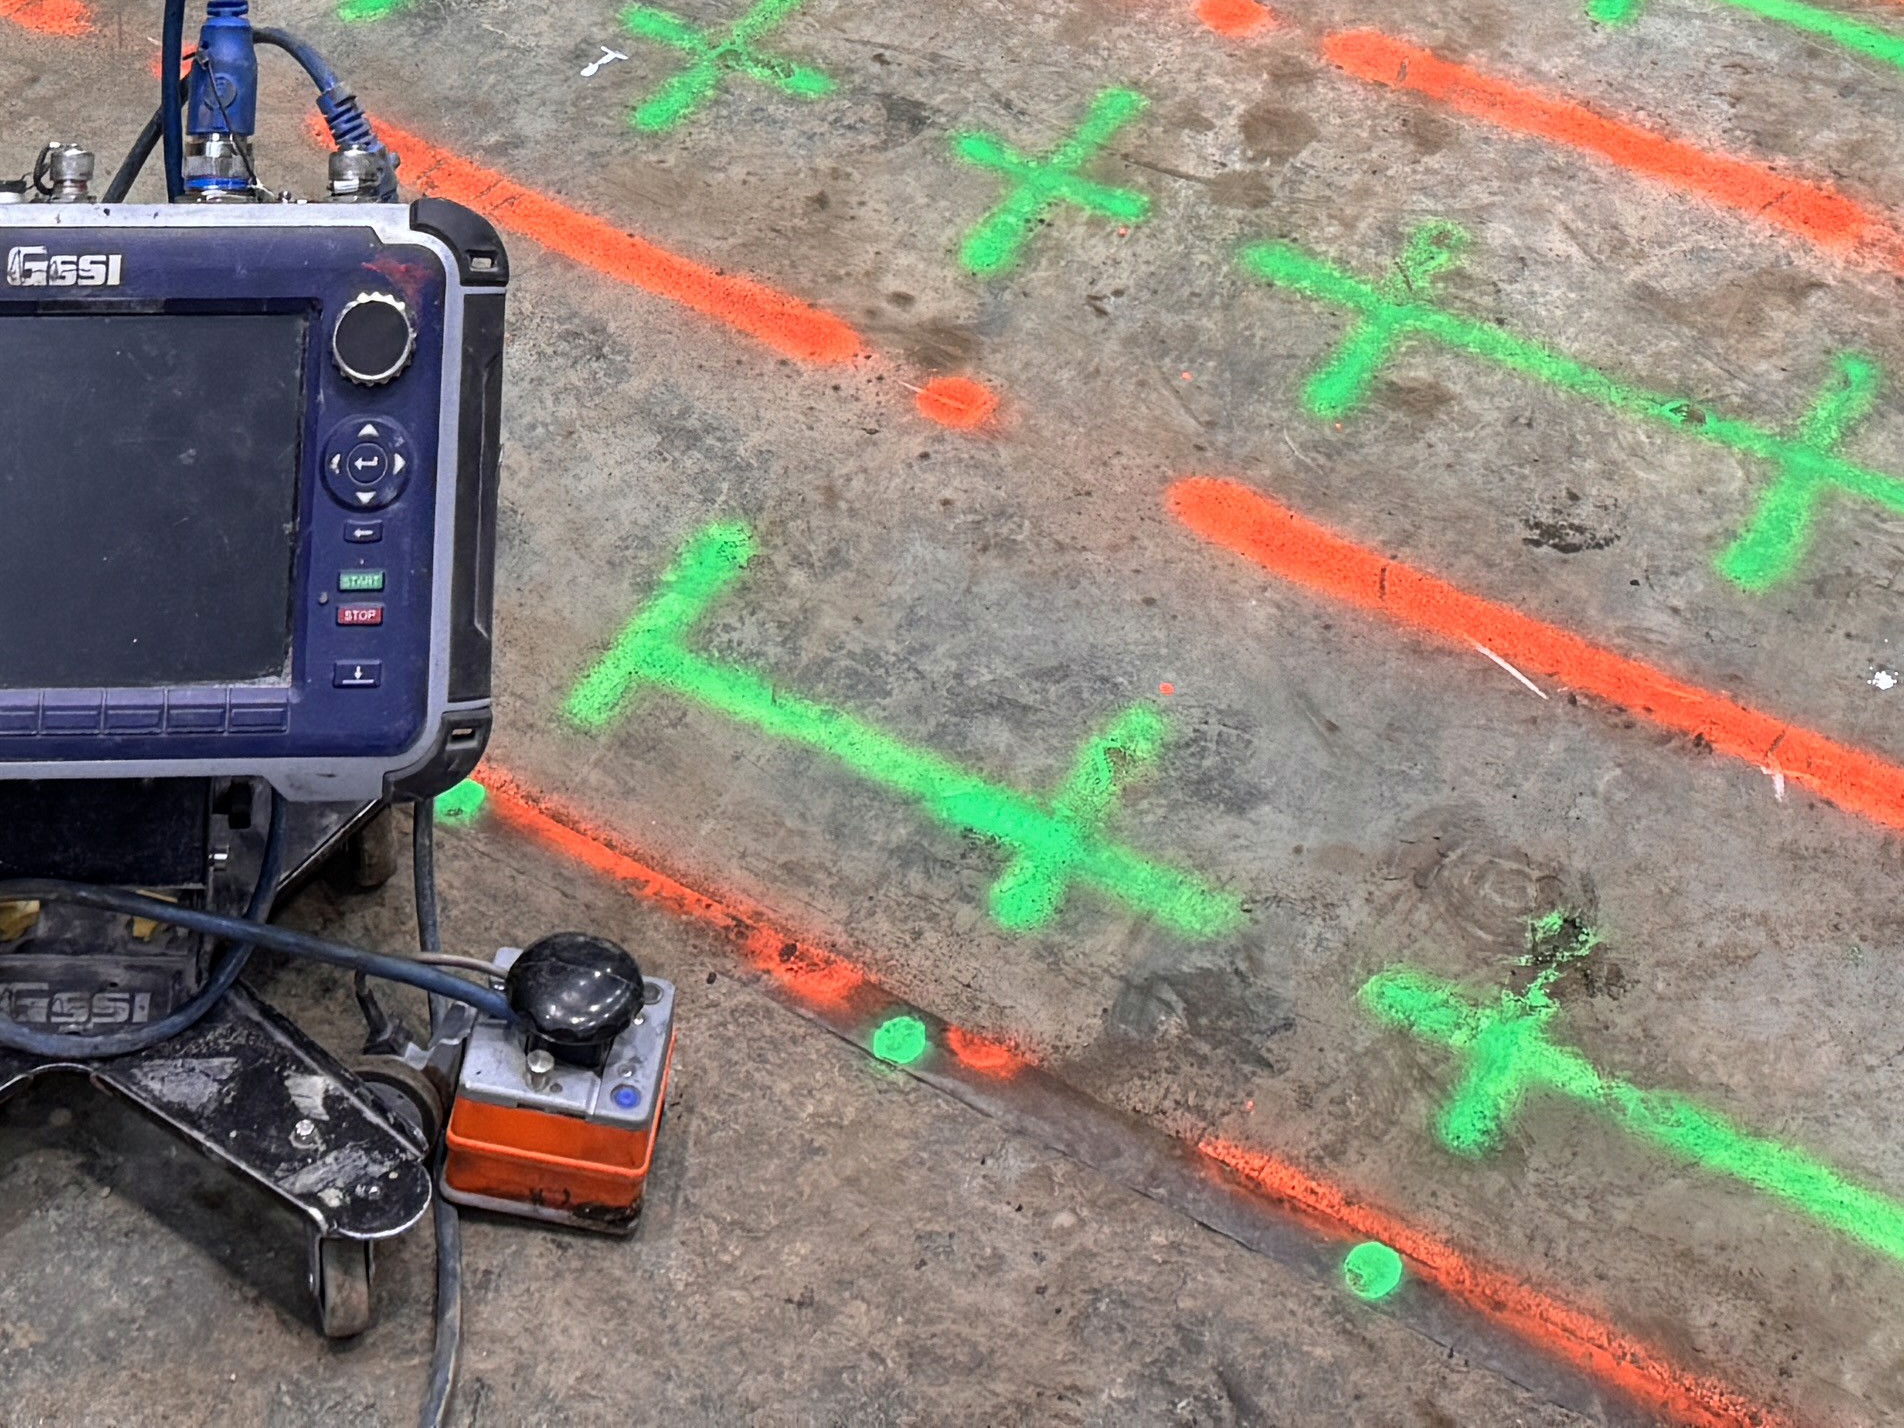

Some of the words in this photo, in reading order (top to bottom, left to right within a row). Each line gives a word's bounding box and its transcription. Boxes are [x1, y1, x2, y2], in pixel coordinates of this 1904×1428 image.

[7, 246, 122, 286] GSSI
[343, 575, 380, 587] START
[344, 609, 376, 621] STOP
